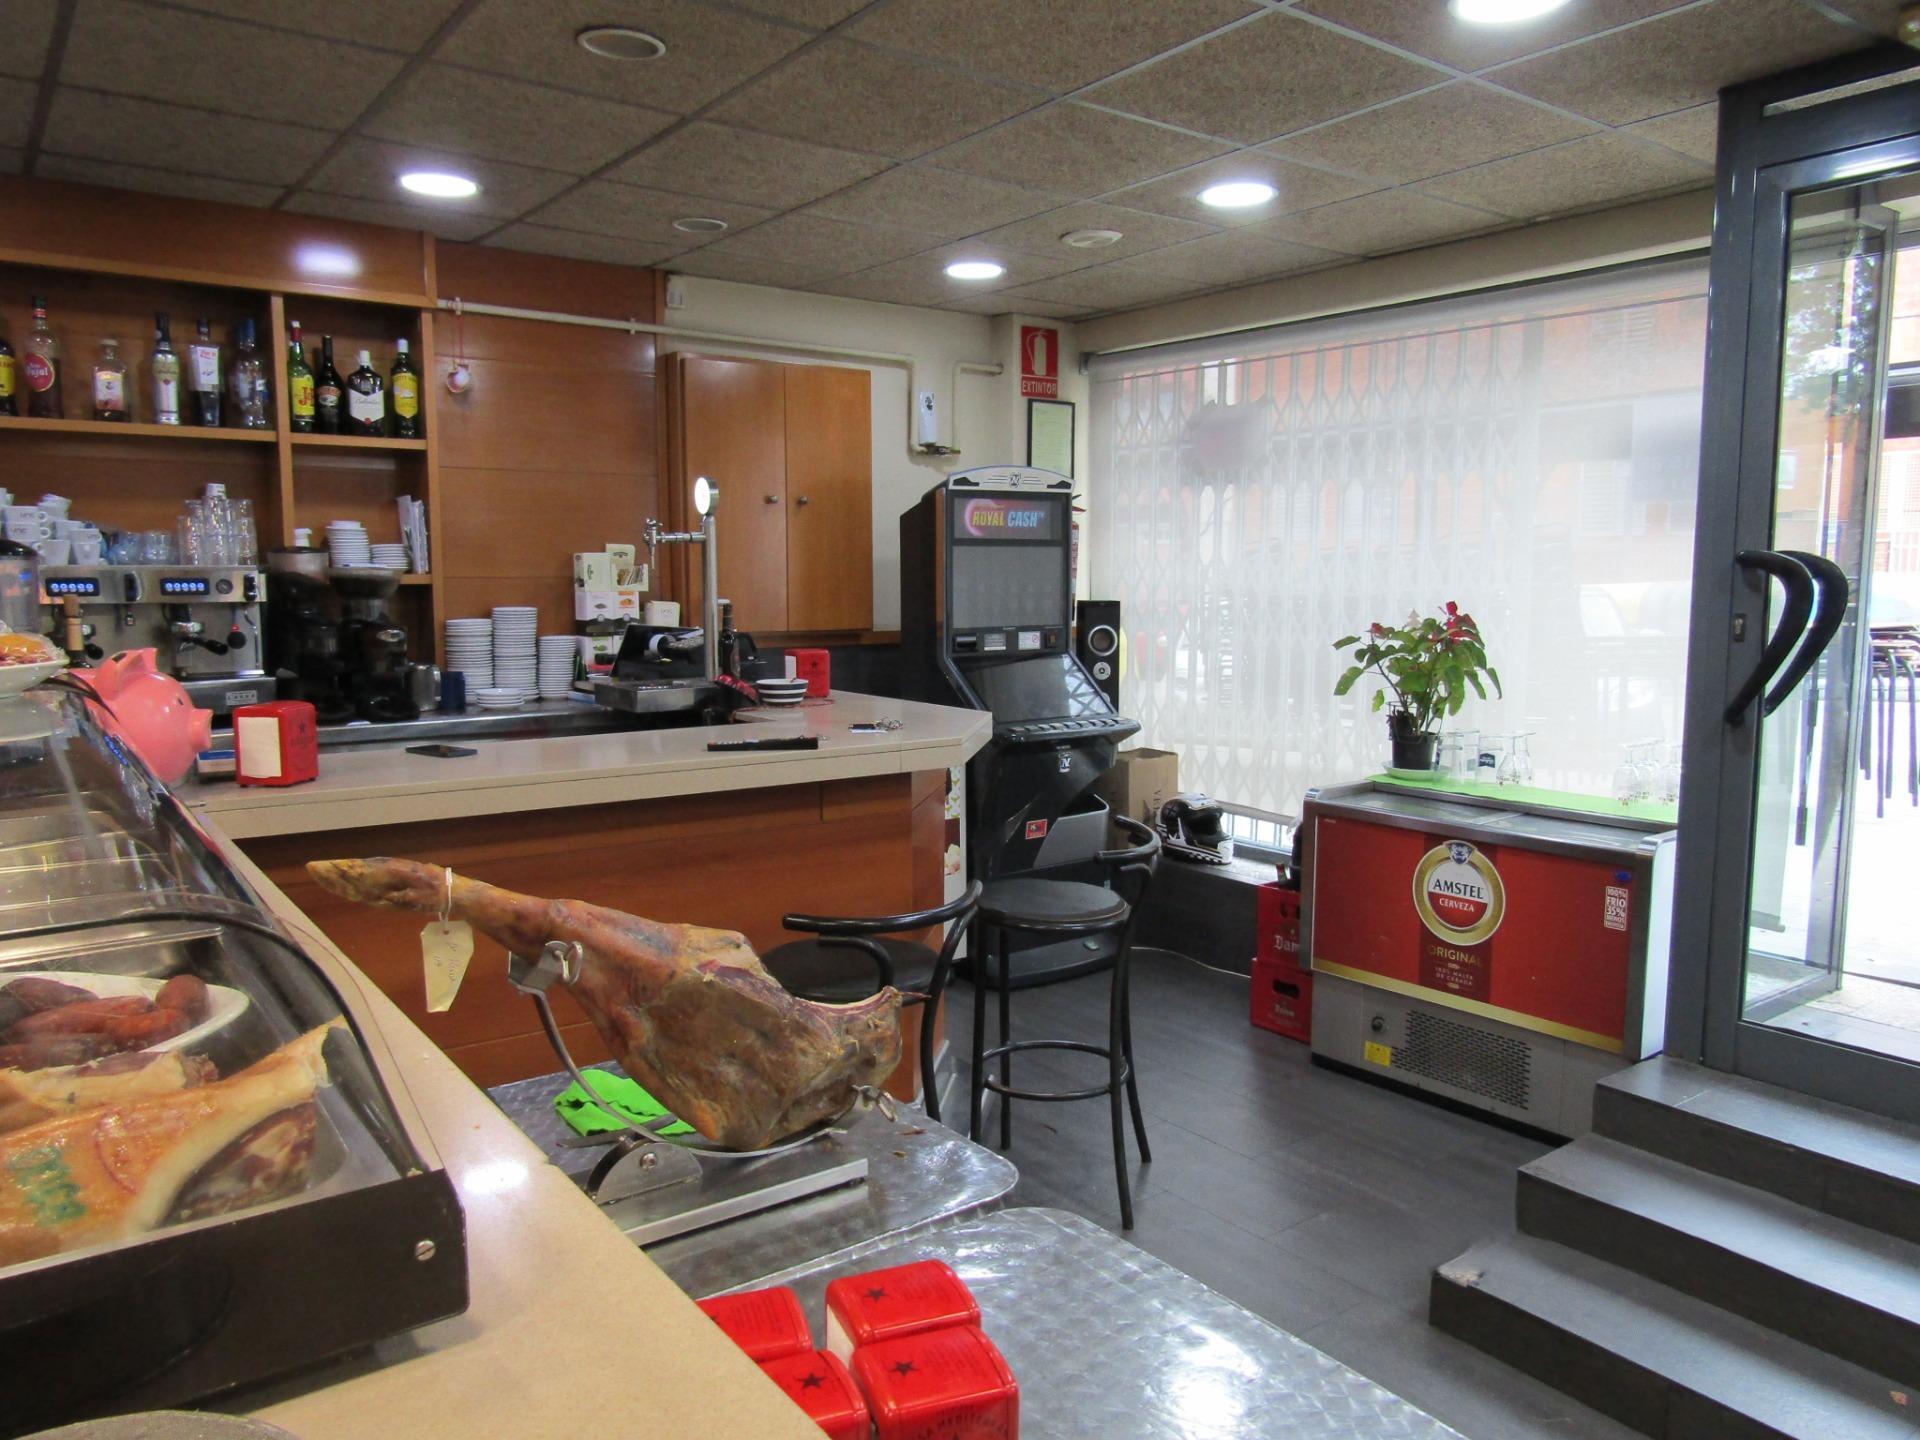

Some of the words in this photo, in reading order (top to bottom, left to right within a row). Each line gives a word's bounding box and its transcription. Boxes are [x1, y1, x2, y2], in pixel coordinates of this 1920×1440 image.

[1022, 380, 1057, 395] EXTINTOR
[972, 511, 1005, 526] ROYAL
[1433, 878, 1484, 900] AMSTEL
[1439, 897, 1475, 912] CERVEZA
[1428, 945, 1484, 967] ORIGINAL
